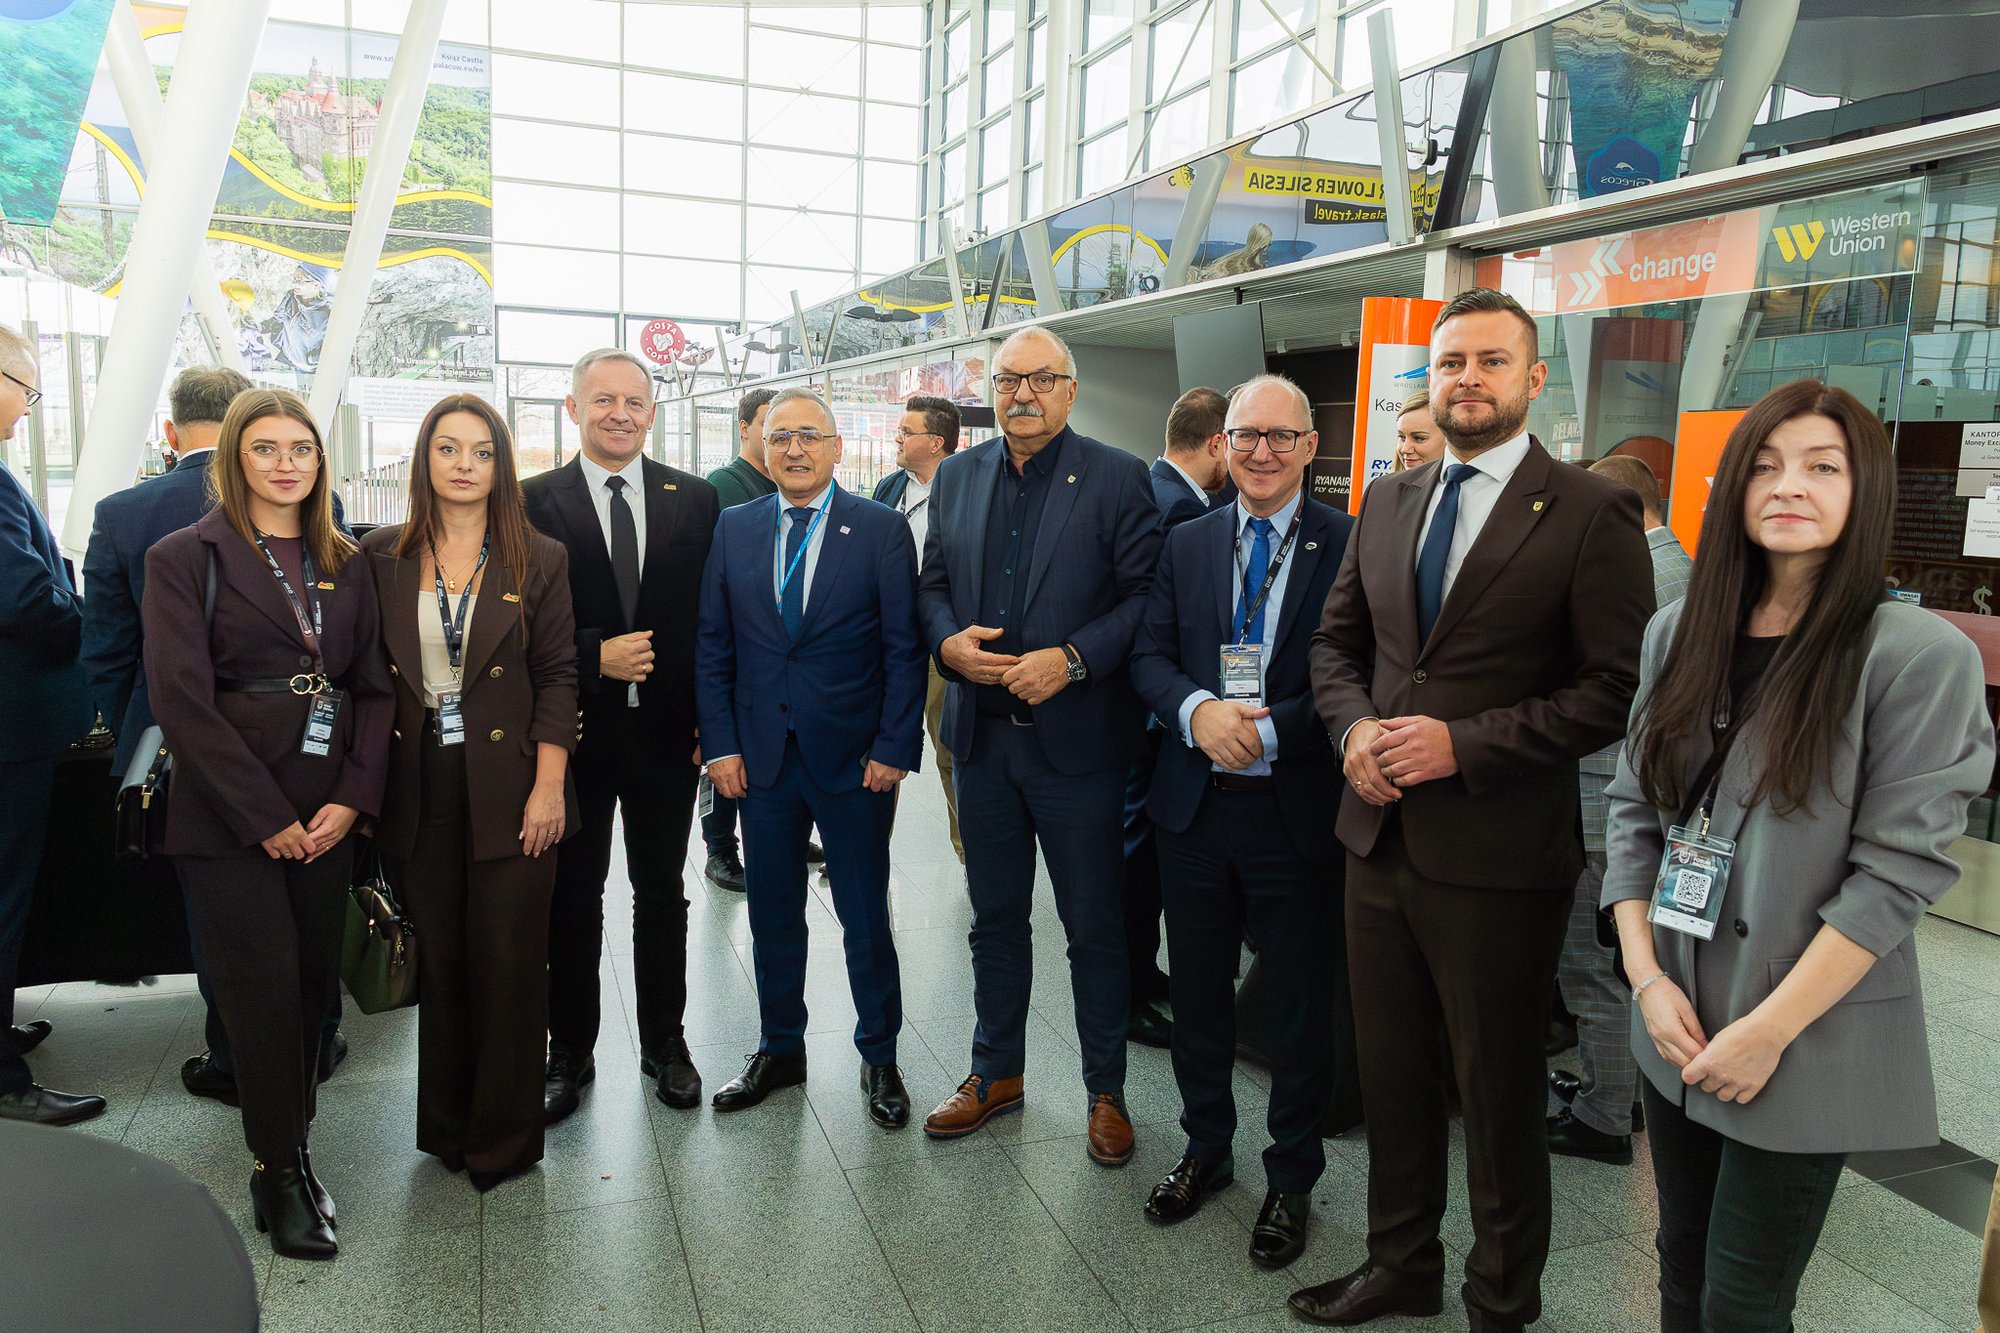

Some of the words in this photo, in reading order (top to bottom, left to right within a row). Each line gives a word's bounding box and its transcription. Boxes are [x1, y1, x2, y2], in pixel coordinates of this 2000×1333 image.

[462, 56, 484, 64] Castle
[1831, 210, 1911, 236] Western
[1829, 235, 1885, 256] Union
[1629, 251, 1716, 283] change
[648, 322, 677, 335] COSTA
[646, 347, 680, 361] COFFE
[1375, 399, 1402, 412] Kas
[1371, 460, 1393, 470] RY
